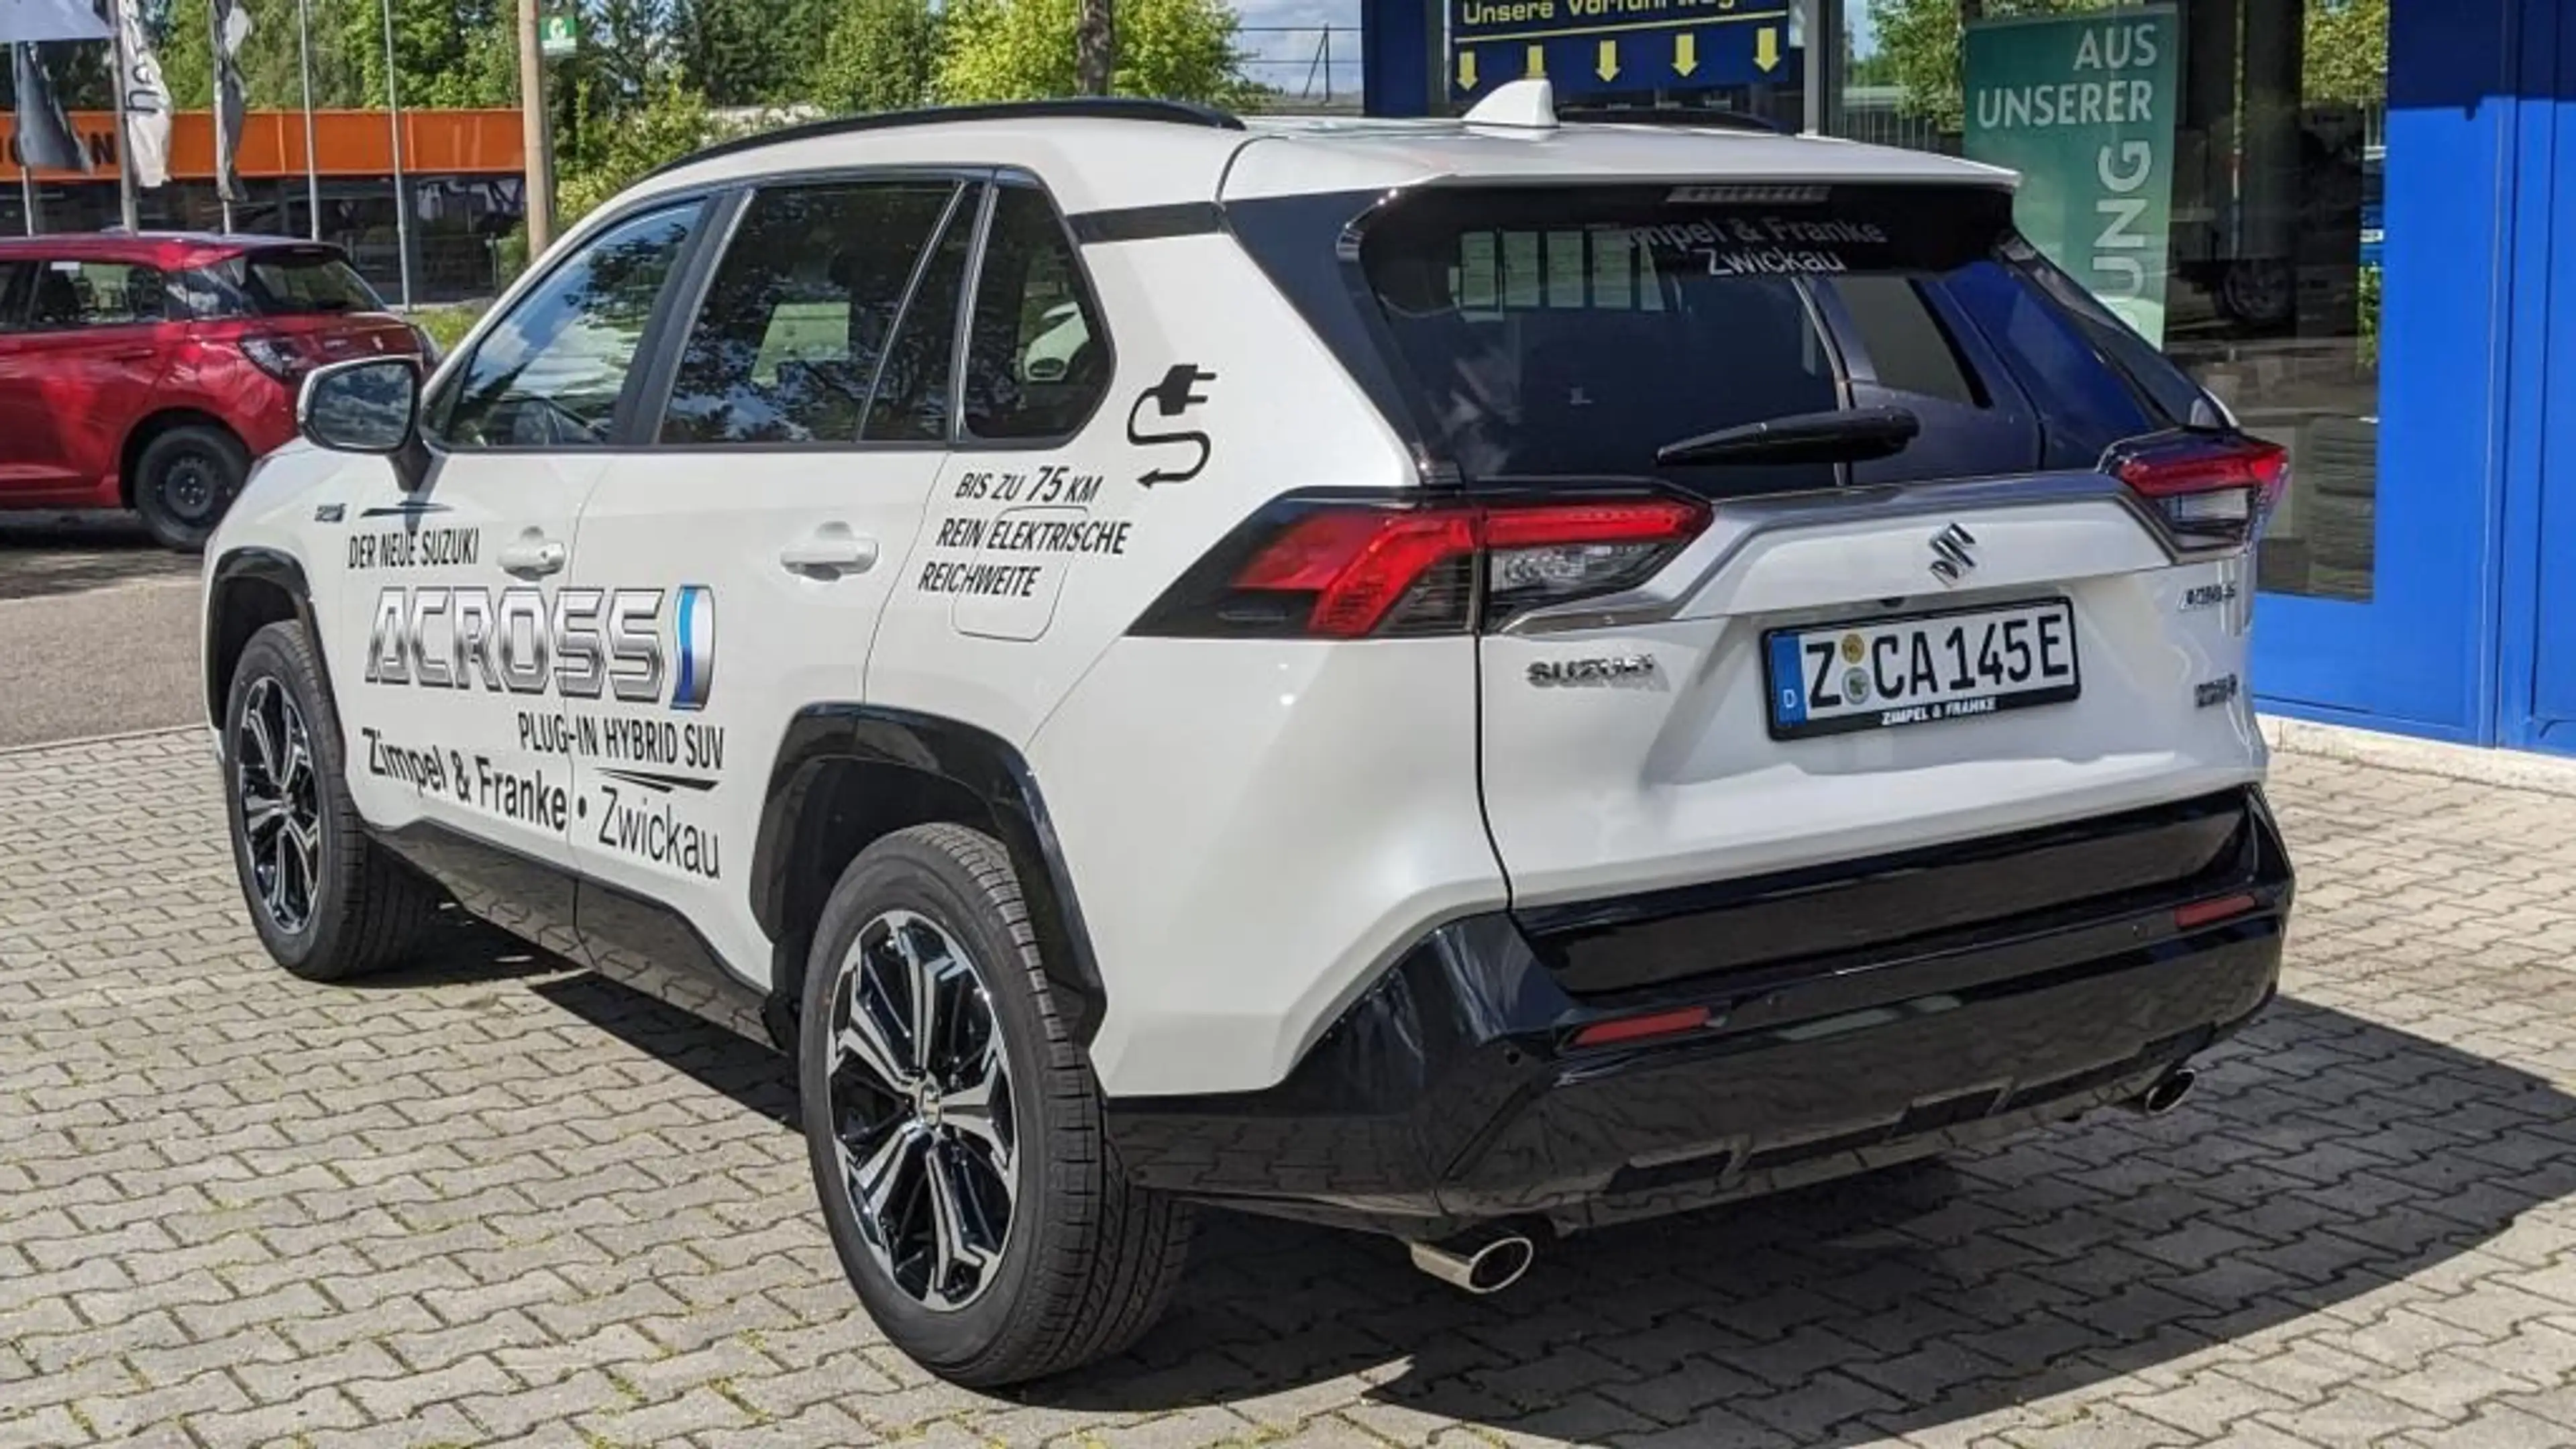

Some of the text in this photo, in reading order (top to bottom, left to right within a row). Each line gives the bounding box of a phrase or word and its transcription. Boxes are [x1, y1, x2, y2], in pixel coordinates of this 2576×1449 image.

[1462, 0, 1554, 24] Unsere
[2072, 24, 2157, 71] AUS
[1977, 80, 2153, 129] UNSERER
[1762, 215, 1889, 244] Franke
[2092, 140, 2152, 312] UNG
[1692, 246, 1848, 276] Zwickau
[954, 466, 1104, 503] BIS ZU 75 KM
[348, 528, 479, 569] DER NEUE SUZUKI
[936, 518, 1132, 554] REIN ELEKTRISCHE
[918, 561, 1042, 596] REICHWEITE
[364, 585, 665, 703] ACROSS
[1806, 641, 1841, 709] Z
[1782, 689, 1798, 708] D
[1881, 706, 1927, 725] ZIMPEL
[519, 712, 724, 769] PLUG-IN HYBRID SUV
[362, 727, 720, 878] Zimpel & Franke Zwickau
